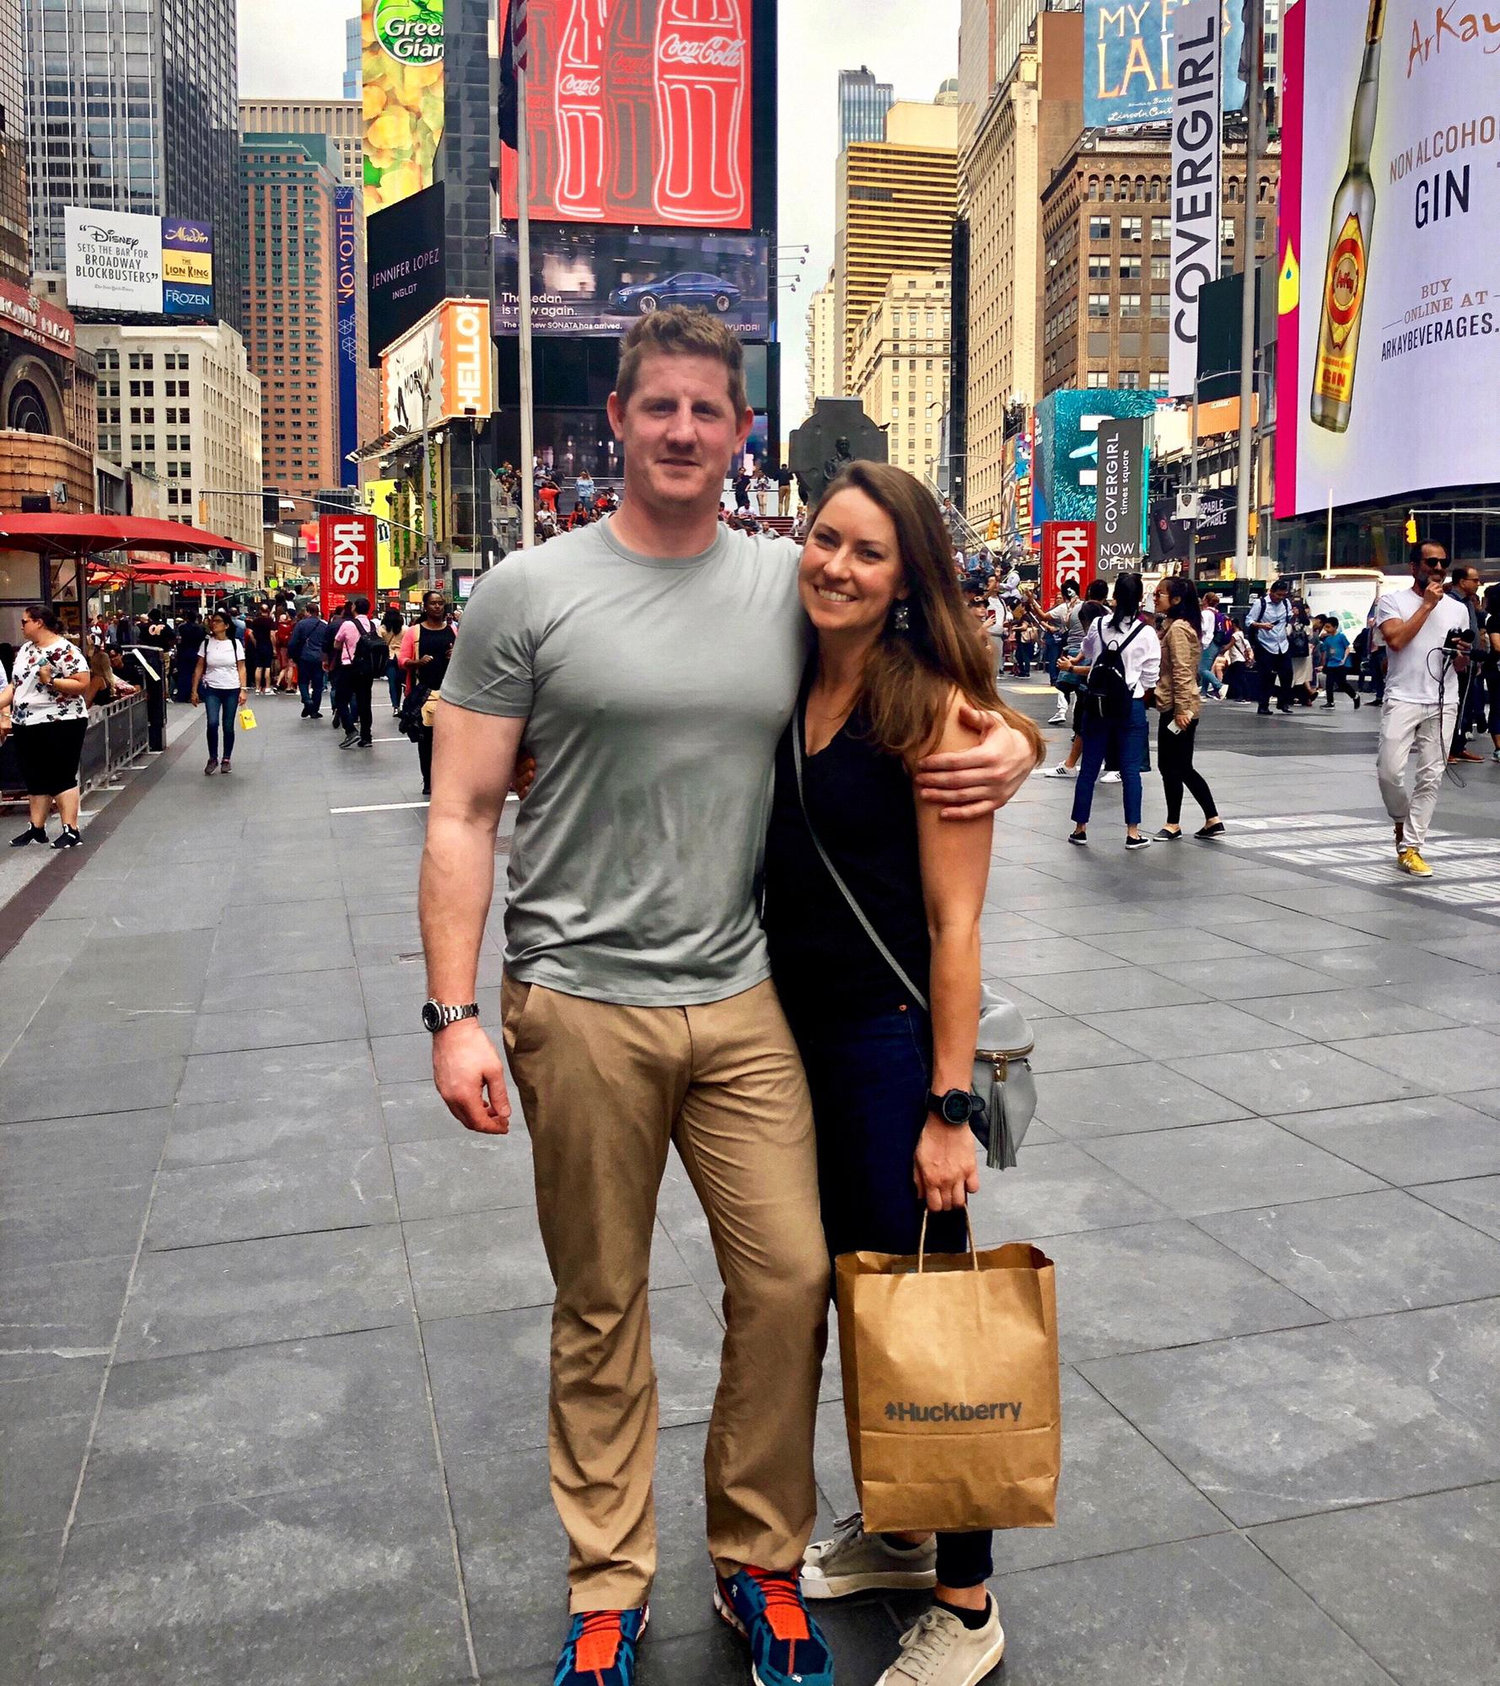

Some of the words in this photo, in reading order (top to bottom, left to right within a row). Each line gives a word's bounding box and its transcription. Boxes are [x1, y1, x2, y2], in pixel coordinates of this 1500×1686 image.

[1098, 1, 1150, 40] MY
[660, 33, 746, 67] Coca-Cola
[1390, 147, 1413, 185] NON
[1174, 16, 1214, 344] COVERGIRL
[1415, 164, 1470, 229] GIN
[165, 226, 209, 243] Aladdin
[77, 242, 96, 253] SETS
[99, 244, 113, 255] THE
[115, 246, 131, 257] BAR
[133, 248, 149, 259] FOR
[336, 199, 354, 304] NOVOTEL
[85, 254, 141, 270] BROADWAY
[165, 263, 186, 277] LION
[187, 266, 209, 279] KING
[182, 258, 191, 266] THE
[372, 260, 411, 290] JENNIFER
[413, 247, 440, 272] LOPEZ
[165, 289, 210, 306] FROZEN
[392, 282, 418, 300] INGLOT
[531, 292, 562, 304] edan
[1421, 278, 1452, 299] BUY
[502, 304, 511, 315] is
[513, 307, 539, 315] nw
[541, 304, 578, 318] again.
[1404, 296, 1453, 324] ONLINE
[1460, 290, 1489, 308] AT
[547, 321, 579, 329] SONATA
[1322, 368, 1346, 387] GIN
[1122, 449, 1130, 484] square
[1104, 432, 1119, 534] COVERGIRL
[1120, 484, 1129, 516] times
[333, 521, 367, 586] tkts
[1056, 527, 1088, 592] tkts
[1100, 543, 1135, 556] NOW
[1098, 556, 1135, 571] OPEN
[898, 1402, 1023, 1422] Huckberry
